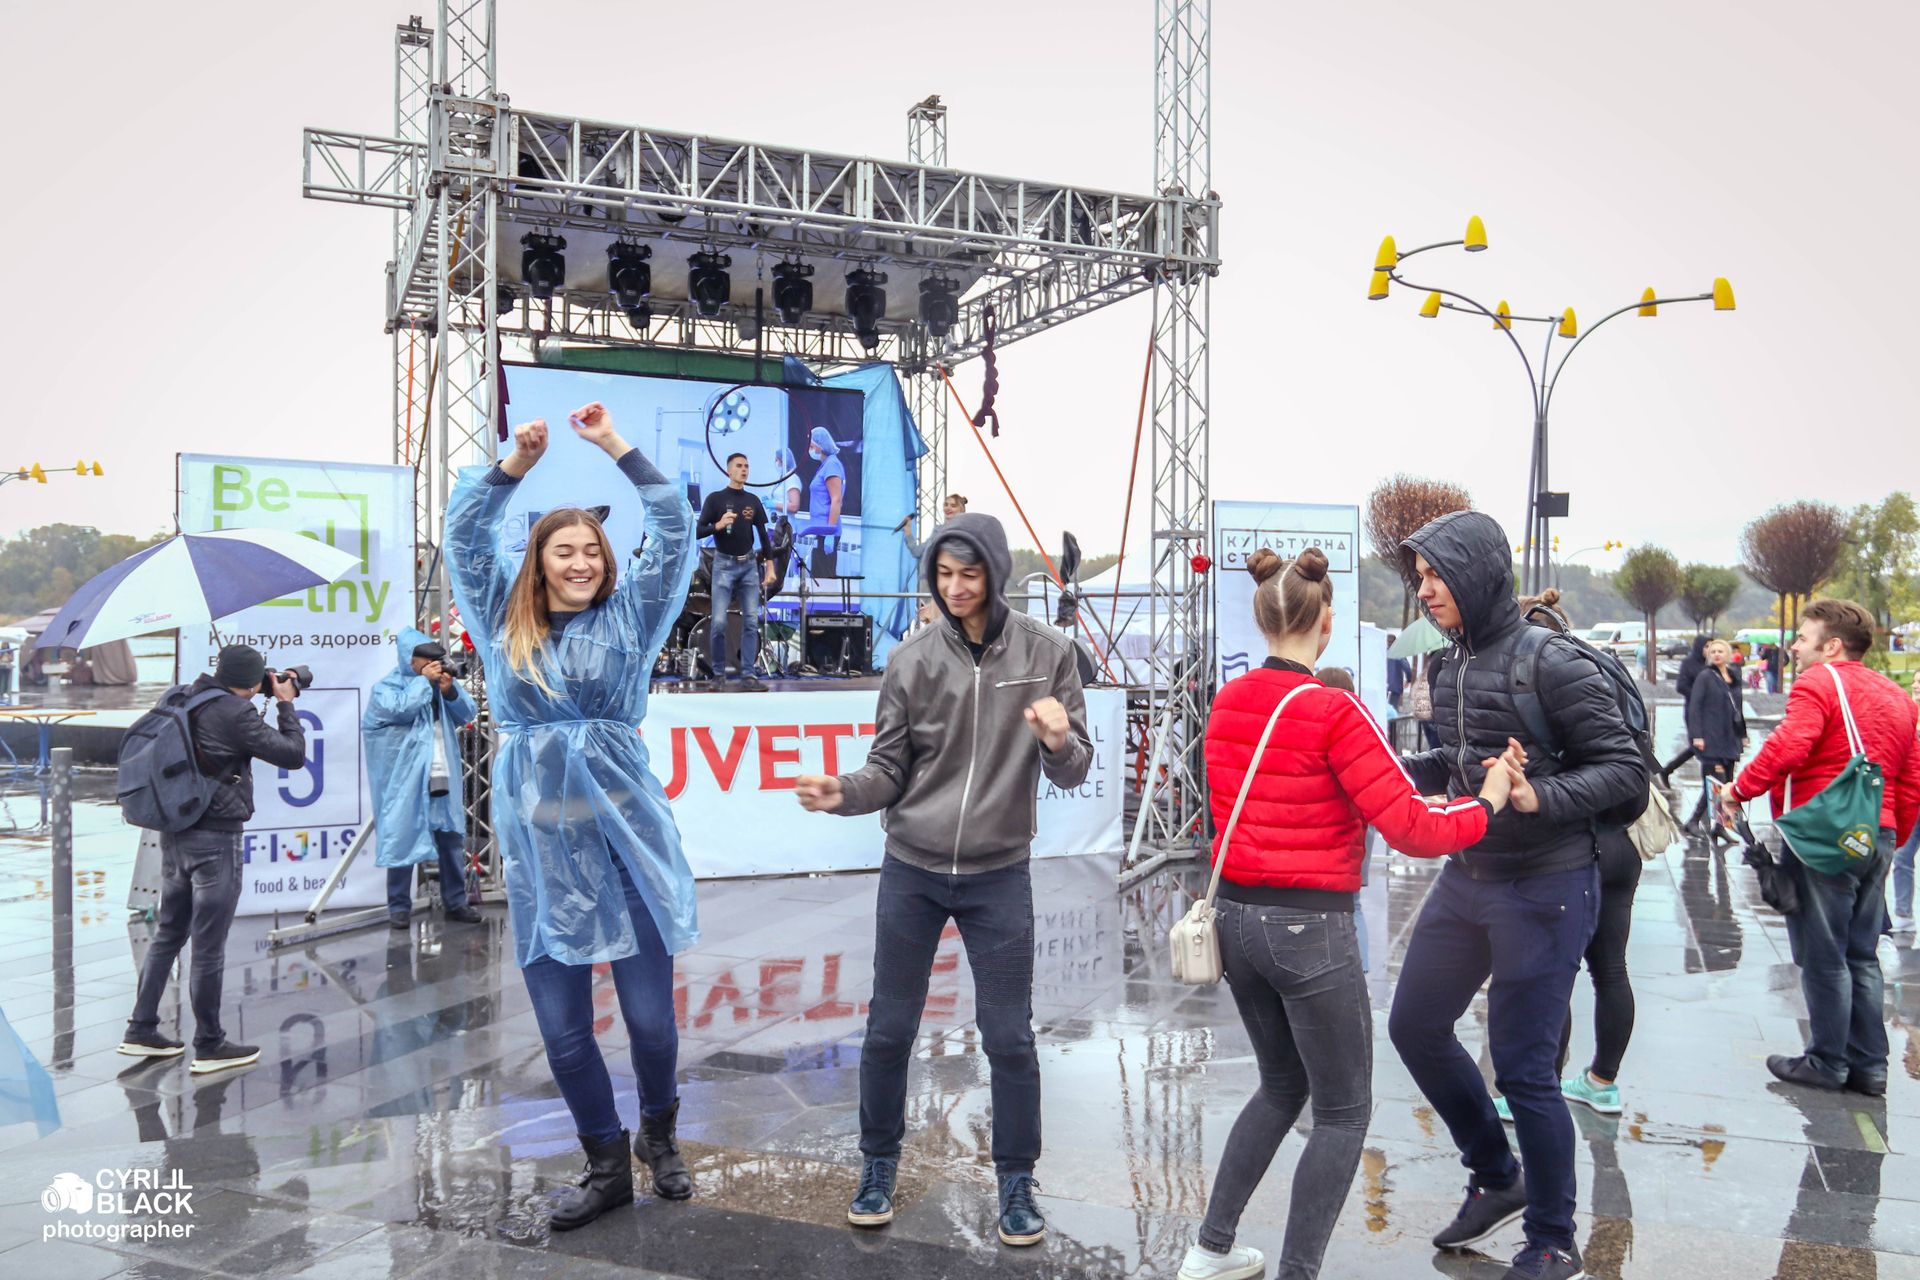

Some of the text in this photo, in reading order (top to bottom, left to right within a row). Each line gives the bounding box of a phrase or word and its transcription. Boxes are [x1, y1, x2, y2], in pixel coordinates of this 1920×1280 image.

[213, 464, 290, 512] Be
[208, 631, 303, 649] Культура
[1036, 780, 1104, 800] ANCE
[254, 877, 283, 894] food
[288, 876, 298, 891] &
